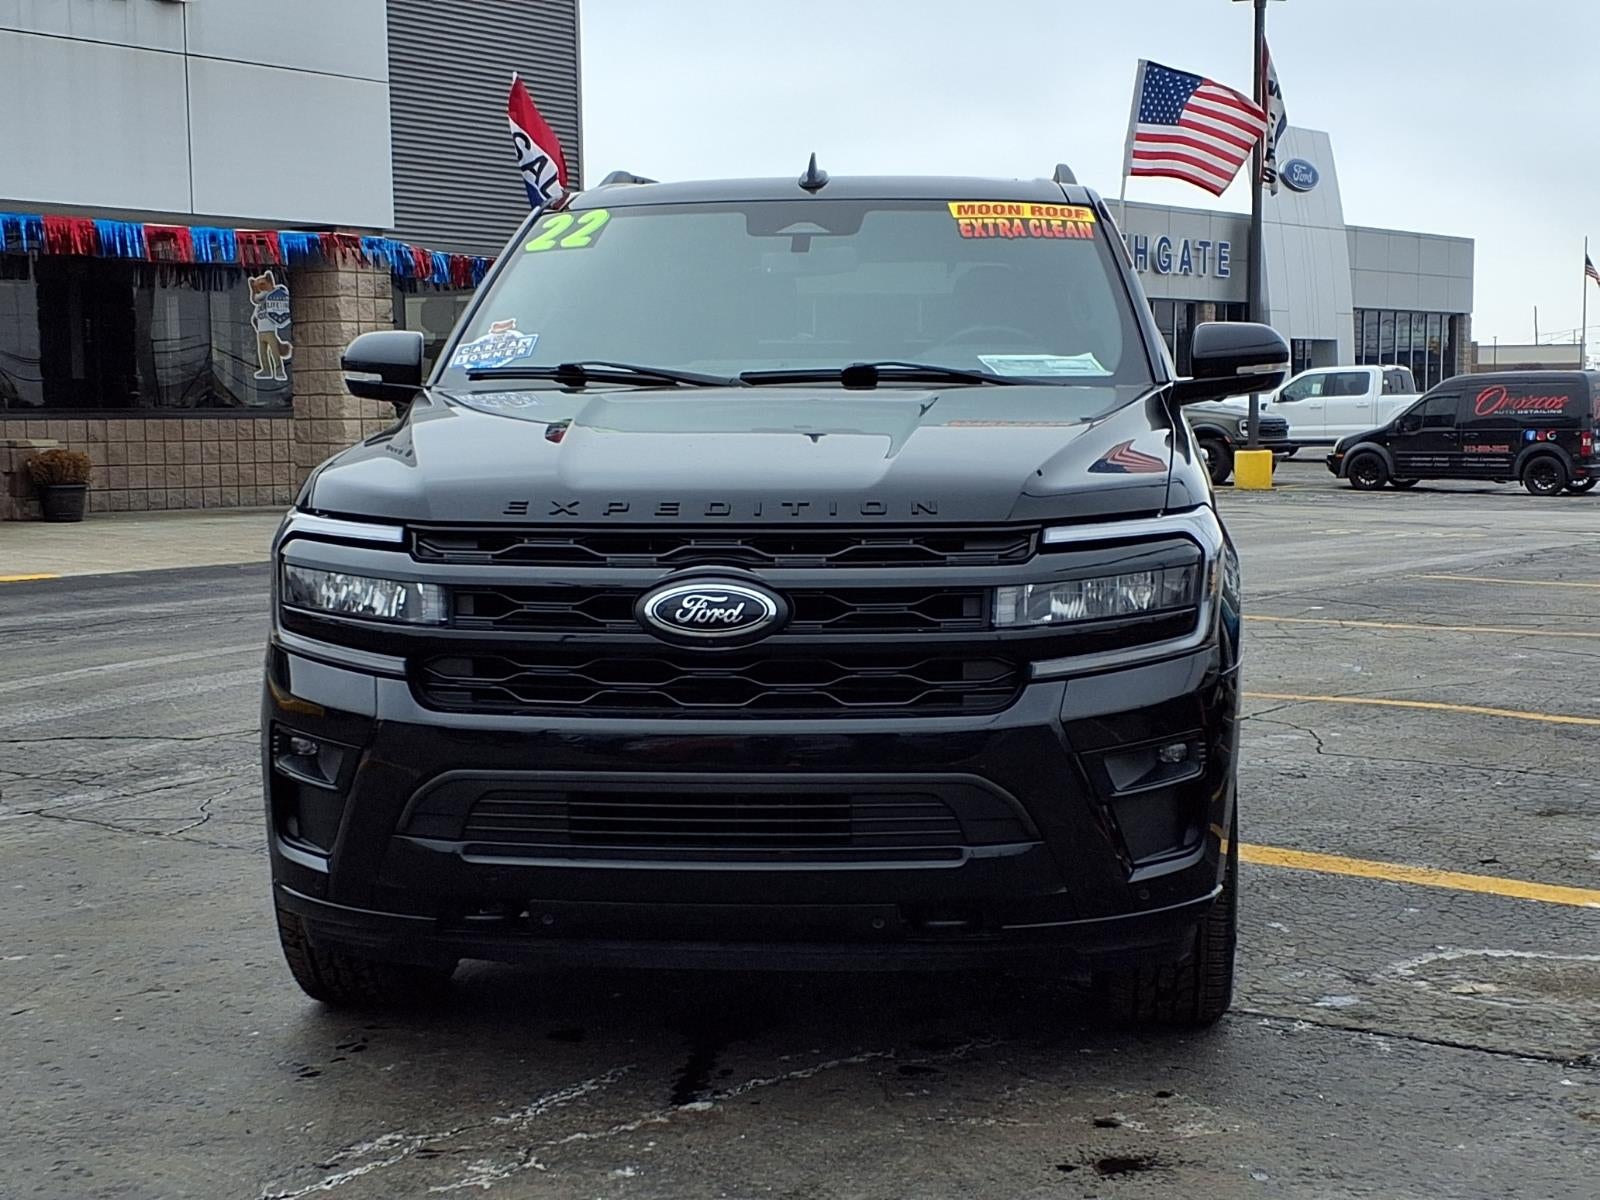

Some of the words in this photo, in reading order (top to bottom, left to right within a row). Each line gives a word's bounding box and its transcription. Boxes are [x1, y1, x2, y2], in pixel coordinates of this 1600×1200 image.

[1293, 164, 1313, 183] Ford
[957, 204, 1021, 216] MOON
[1030, 205, 1090, 219] ROOF
[525, 209, 610, 251] 22
[958, 217, 1027, 238] EXTRA
[1028, 218, 1095, 239] CLEAN
[1120, 233, 1231, 278] HGATE
[461, 337, 533, 355] CARFAX
[469, 347, 526, 361] OWNER
[502, 501, 939, 516] EXPEDITION
[675, 594, 745, 624] Ford
